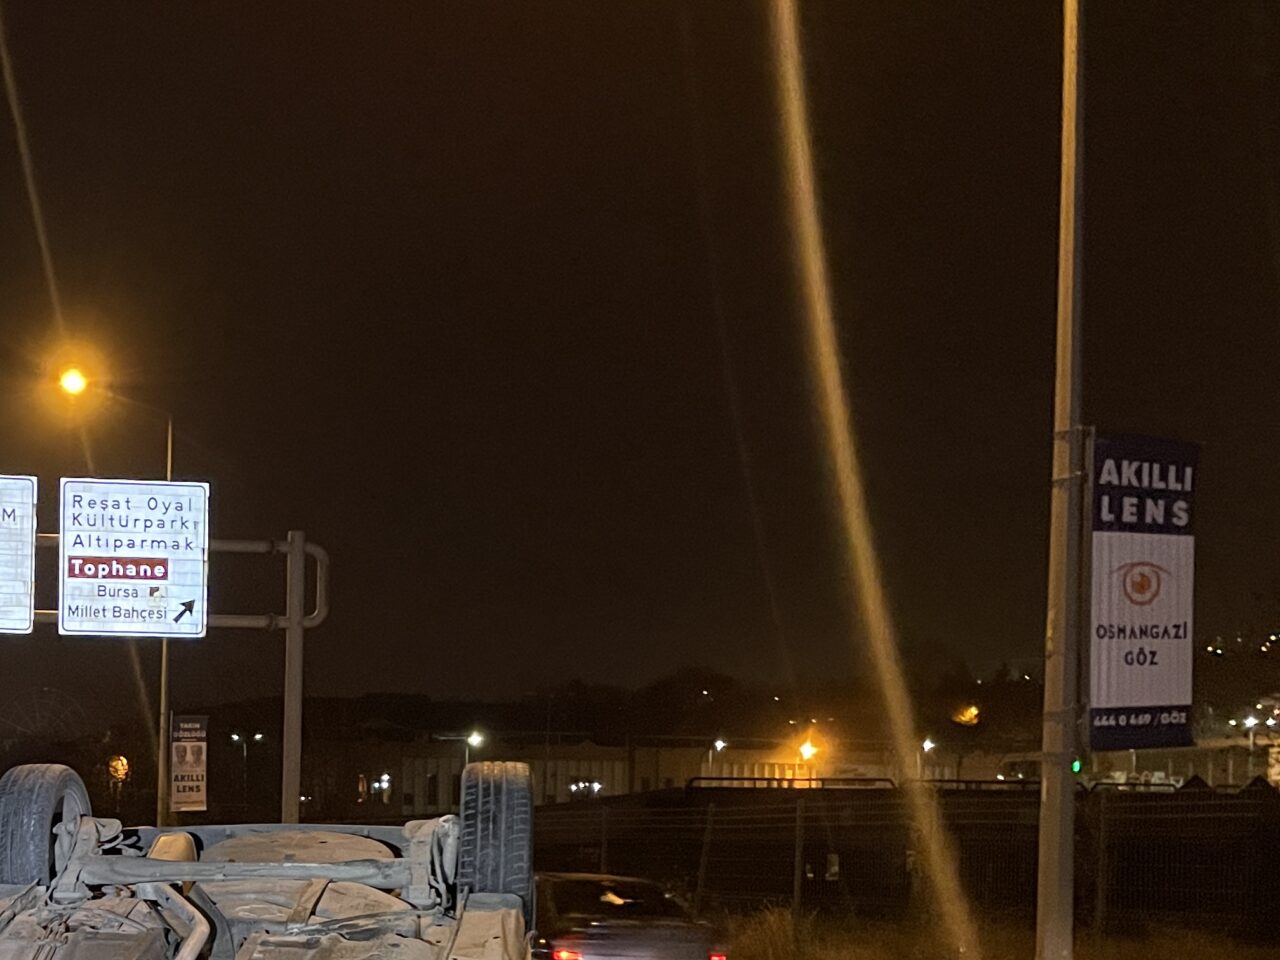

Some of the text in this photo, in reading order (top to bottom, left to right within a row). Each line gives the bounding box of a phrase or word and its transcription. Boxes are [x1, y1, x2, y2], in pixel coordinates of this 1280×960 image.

[1099, 459, 1192, 491] AKILLI
[72, 494, 192, 514] Reşat Oyal
[1099, 495, 1190, 527] LENS
[72, 534, 194, 552] Altıparmak
[71, 559, 165, 579] Tophane
[97, 585, 139, 598] Bursa
[68, 604, 167, 622] Millet Bahçesi
[1096, 620, 1188, 641] OSMANGAZİ
[1124, 648, 1158, 667] GÖZ
[176, 785, 201, 793] LENS
